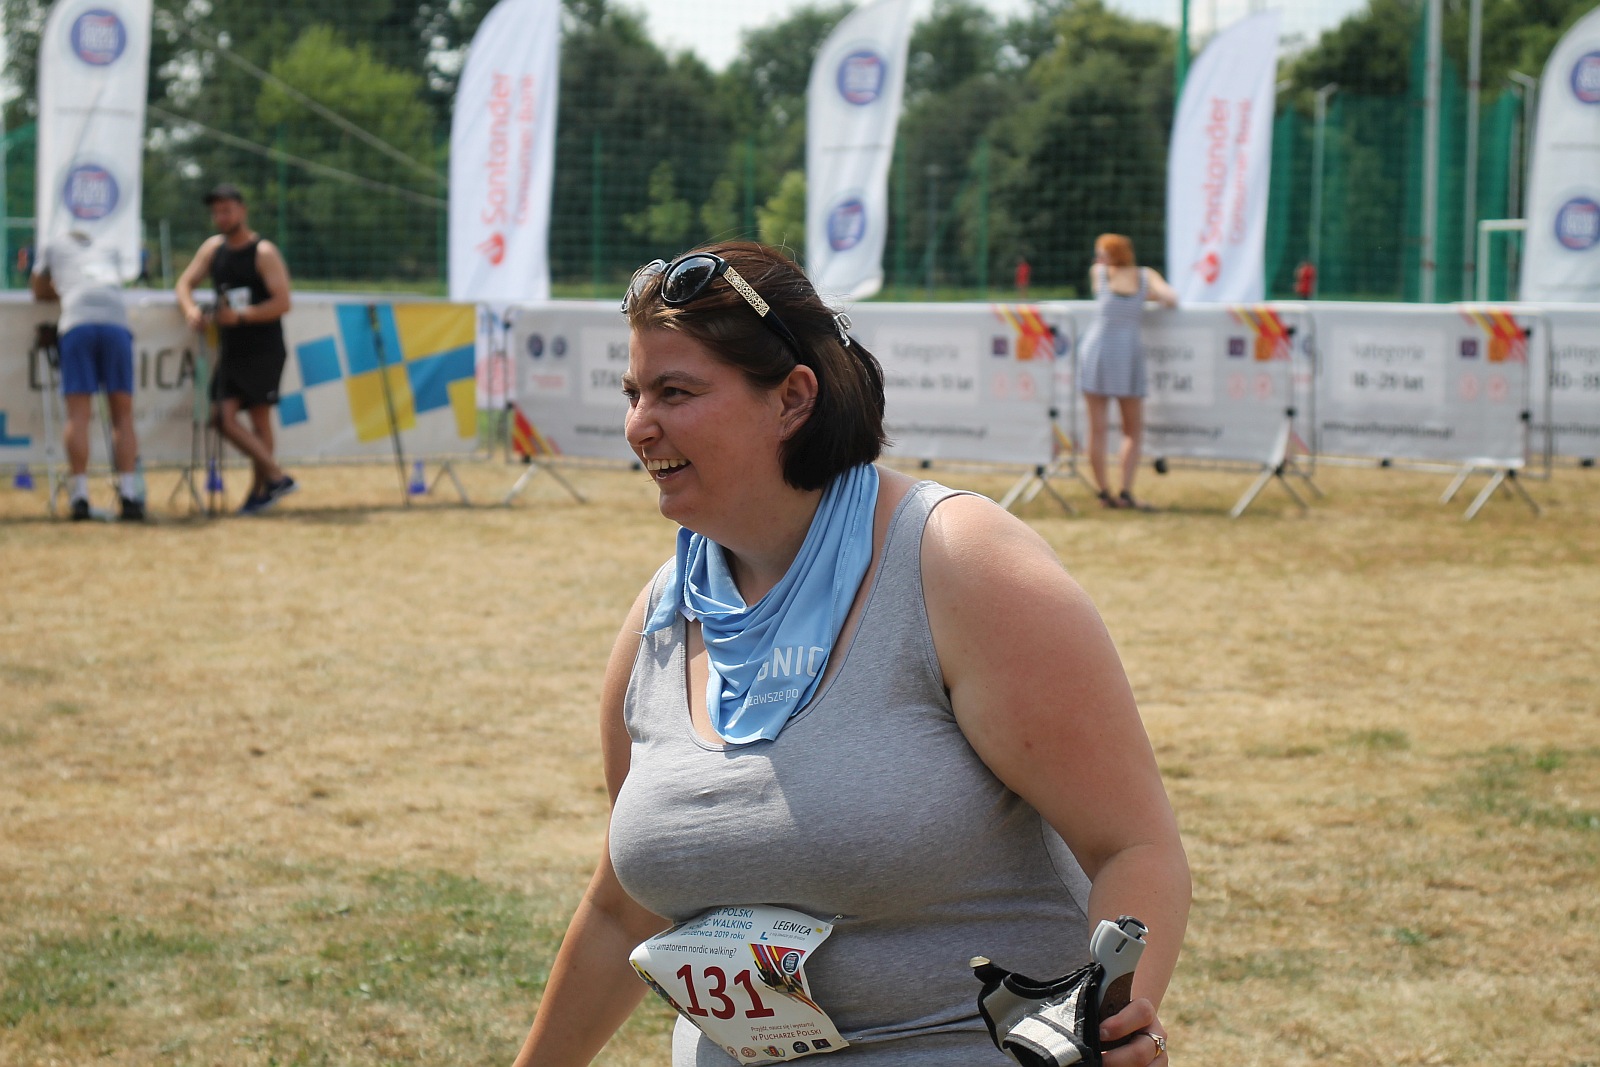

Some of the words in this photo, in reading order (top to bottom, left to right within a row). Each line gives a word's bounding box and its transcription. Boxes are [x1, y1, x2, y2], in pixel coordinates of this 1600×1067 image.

[482, 69, 510, 226] Santander
[748, 690, 784, 706] zawsze
[785, 688, 799, 702] po
[722, 907, 754, 918] POLSKI
[712, 919, 753, 930] WALKING
[772, 920, 812, 936] LEGNICA
[713, 930, 729, 938] 2019
[730, 932, 745, 940] roku
[657, 943, 688, 952] amatorem
[688, 944, 709, 955] nordic
[709, 945, 737, 959] walking?
[676, 964, 775, 1020] 131
[796, 1029, 822, 1039] POLSKI
